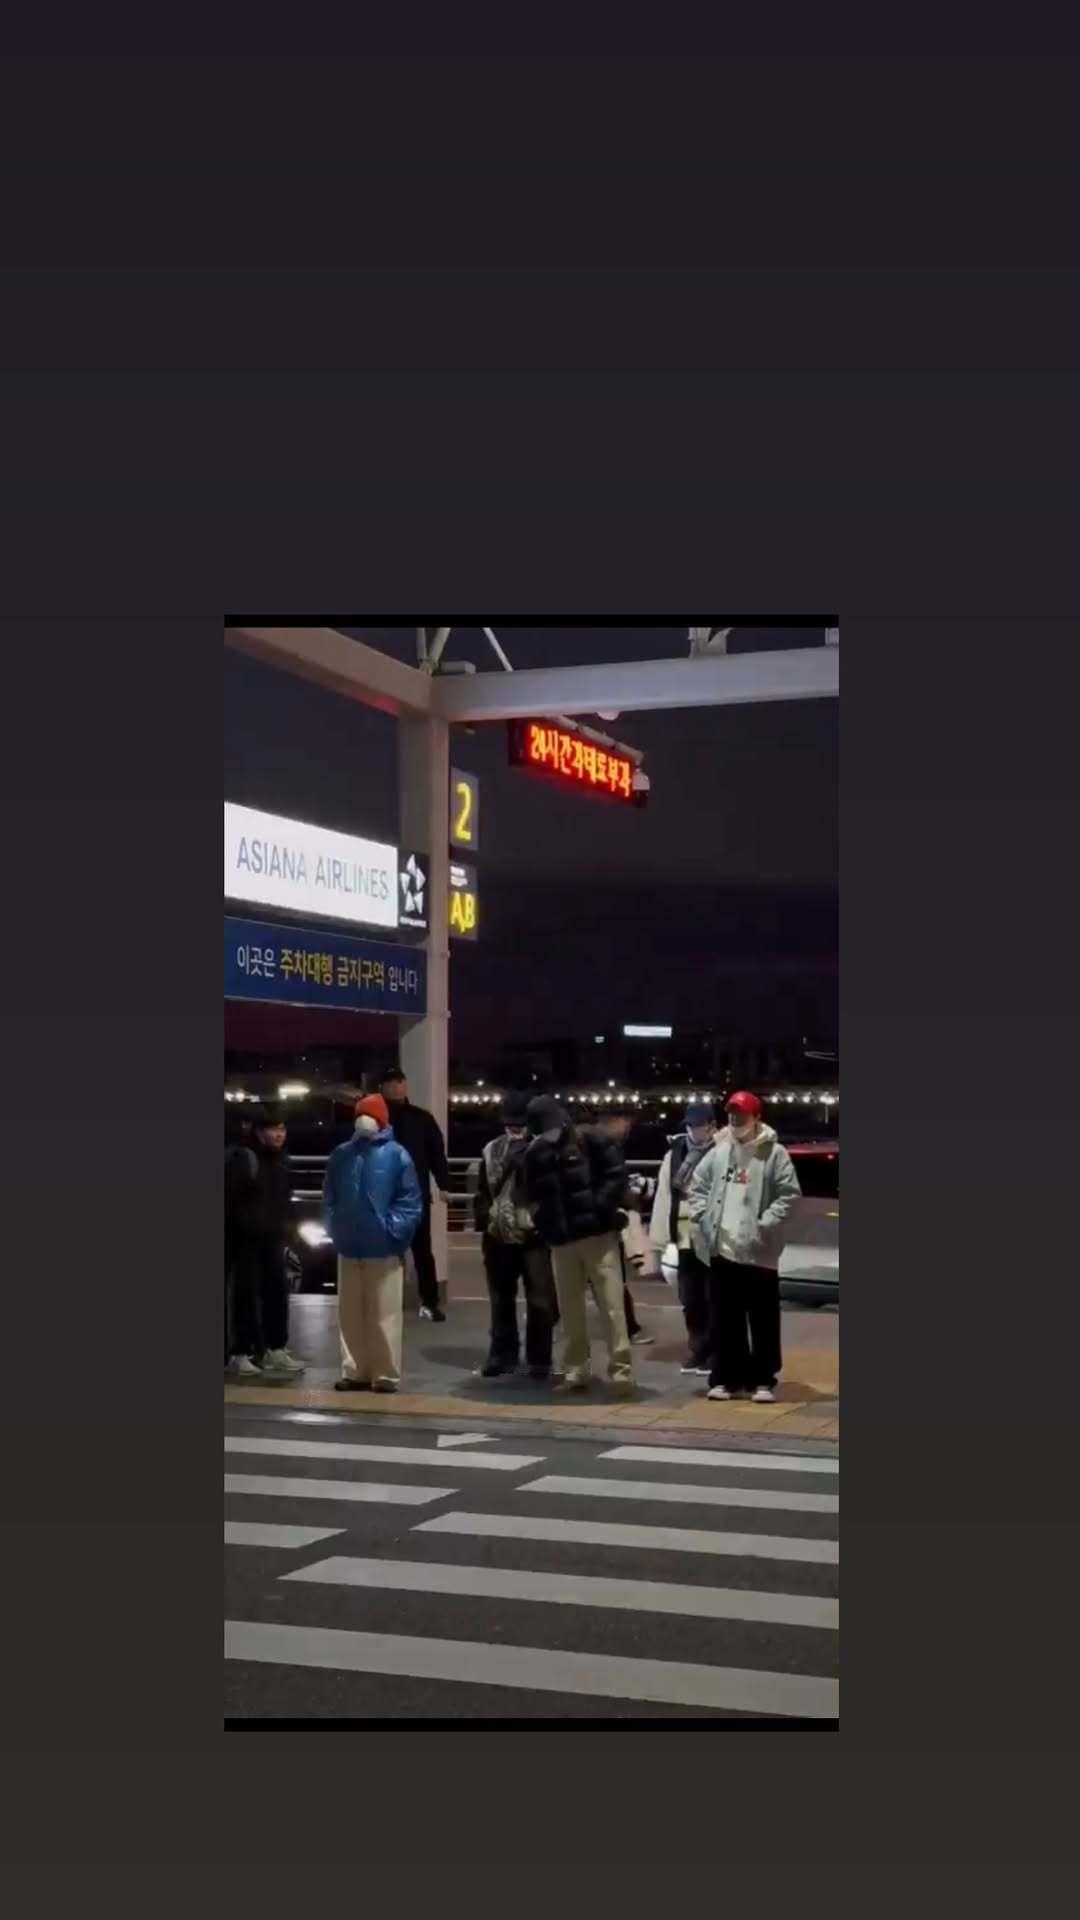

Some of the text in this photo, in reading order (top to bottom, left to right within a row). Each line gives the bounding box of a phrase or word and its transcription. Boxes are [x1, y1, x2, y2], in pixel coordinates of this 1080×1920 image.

[456, 782, 471, 841] 2
[236, 837, 389, 901] ASIANA AIRLINES
[237, 945, 419, 995] 이곳은 주차대행 금지구역 입니다
